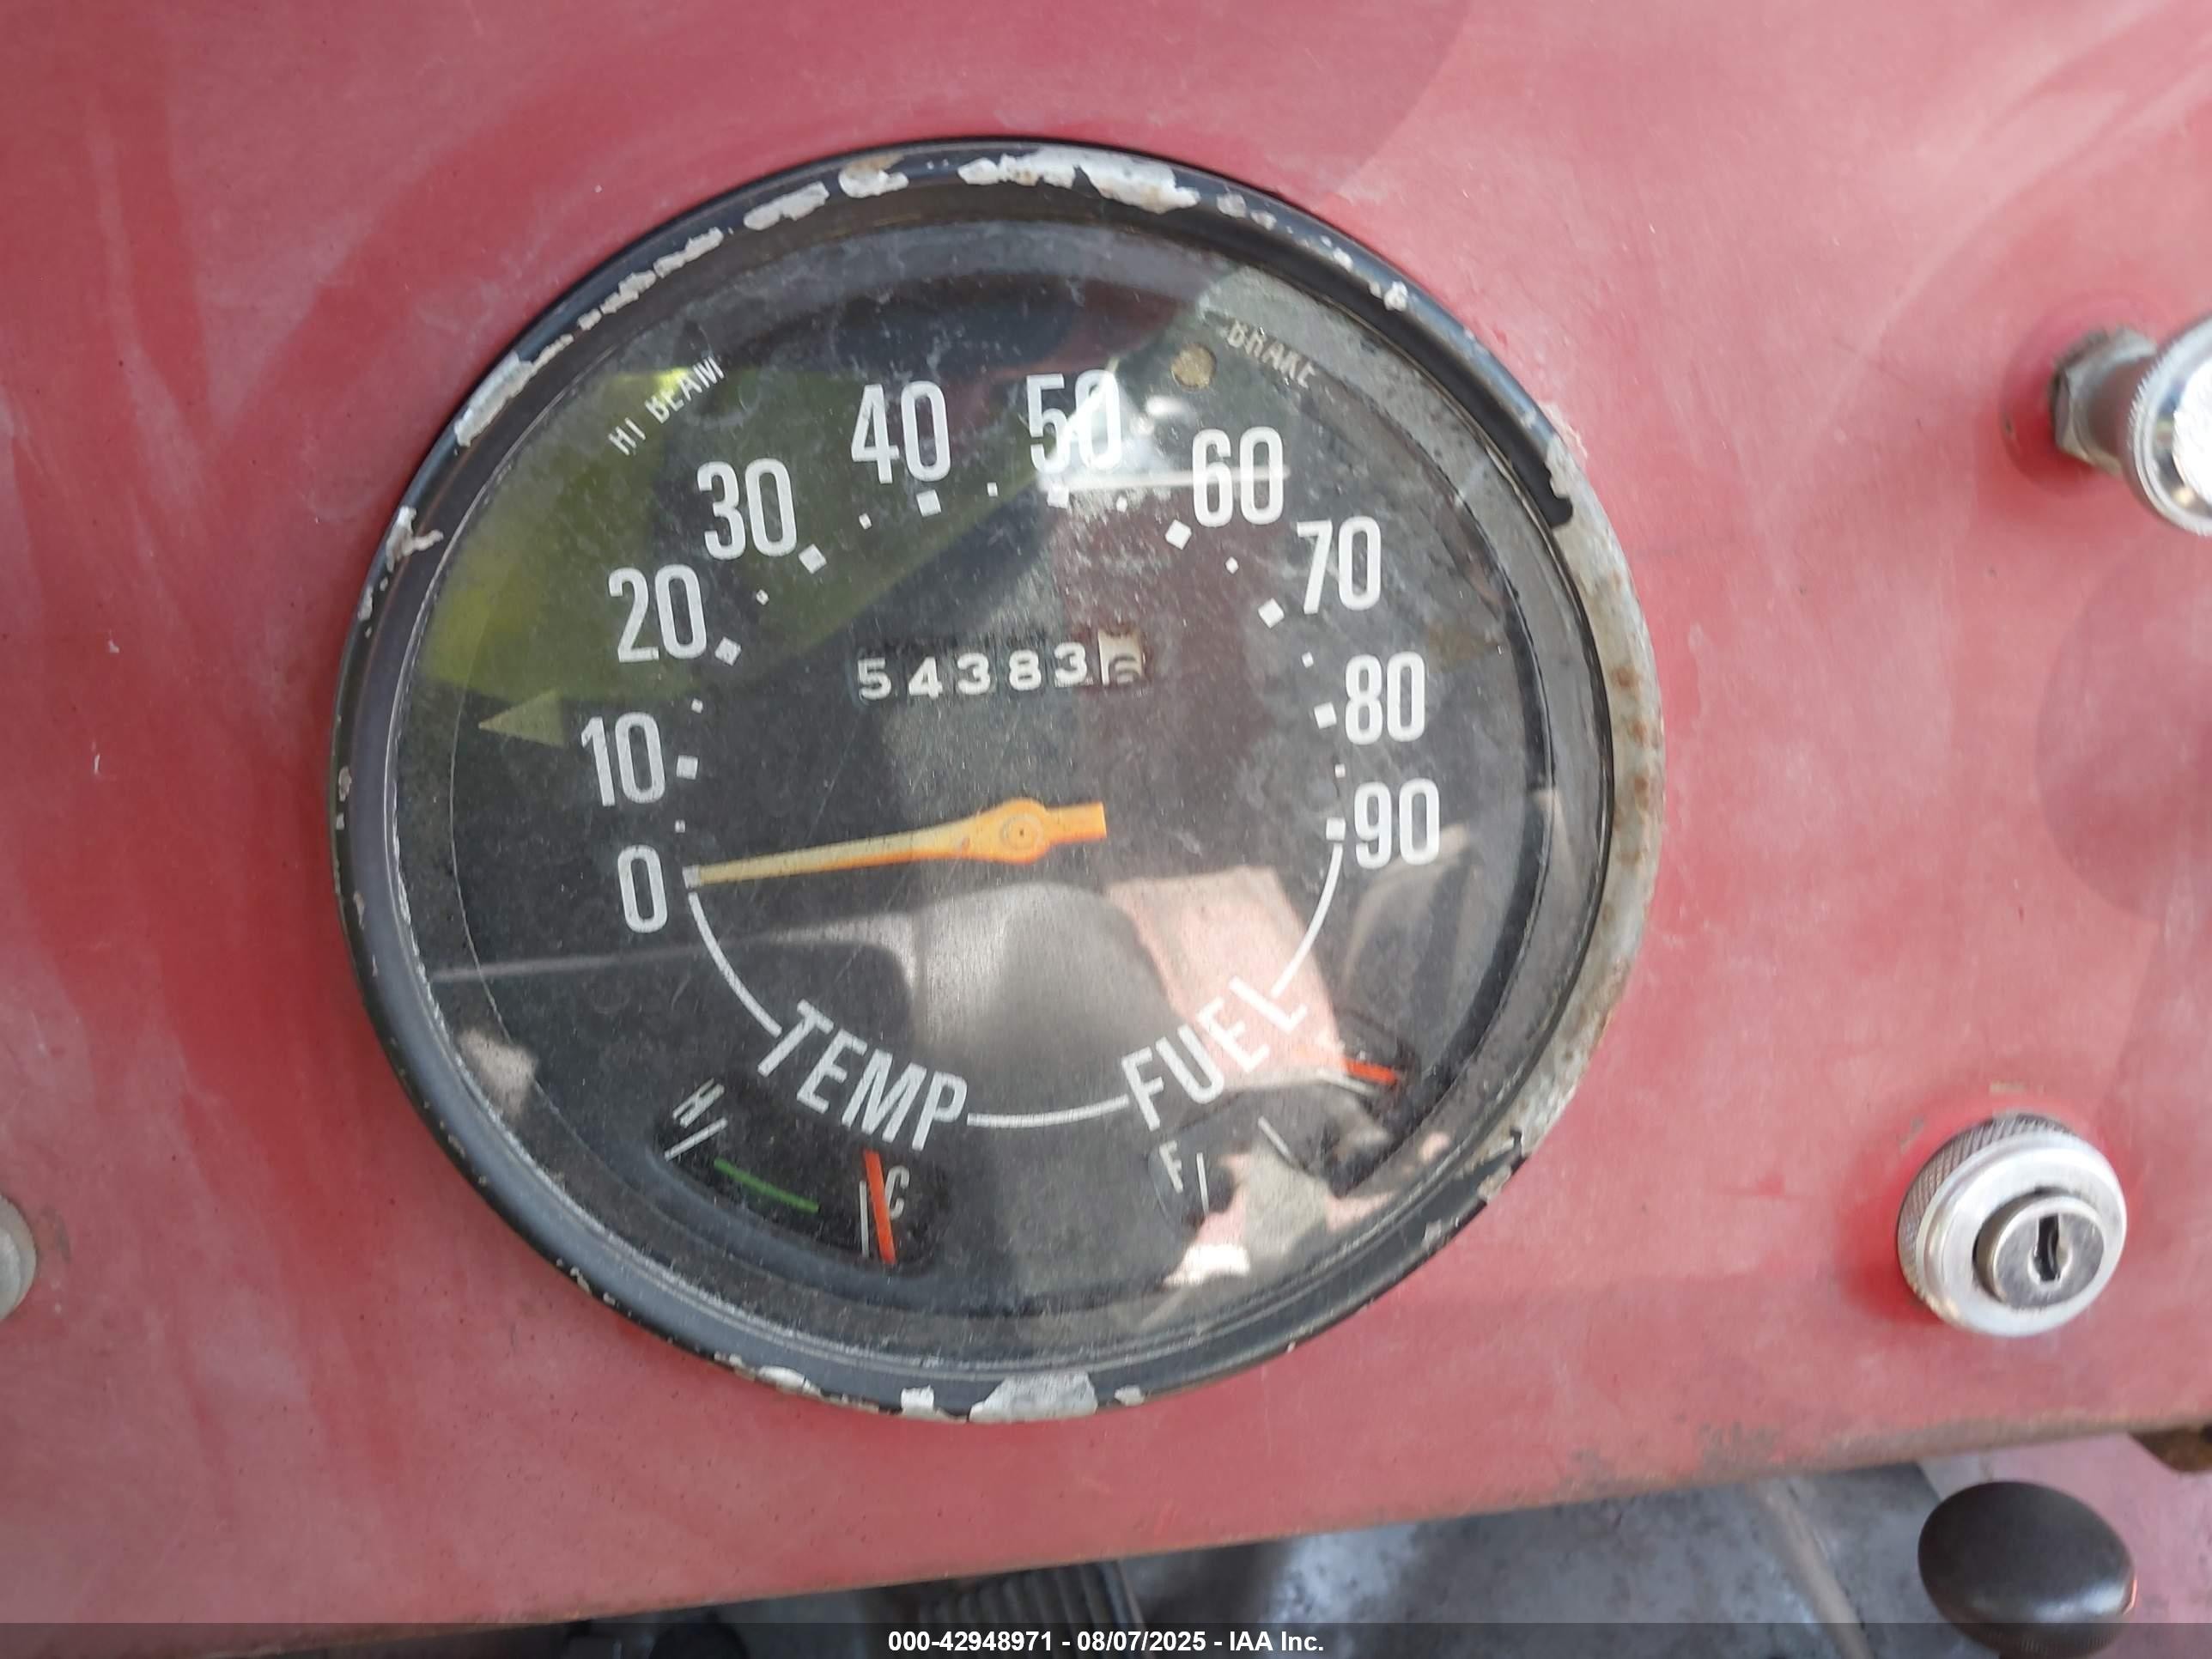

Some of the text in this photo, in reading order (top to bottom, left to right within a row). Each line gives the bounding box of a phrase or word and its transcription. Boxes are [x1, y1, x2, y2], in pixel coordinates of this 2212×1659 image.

[608, 418, 646, 456] HI
[851, 380, 951, 484] 40
[1026, 369, 1121, 474] 50
[696, 458, 798, 560] 30
[1192, 426, 1285, 527] 60
[1297, 515, 1382, 614] 70
[608, 563, 708, 663] 20
[1345, 651, 1425, 745] 80
[580, 712, 665, 806] 10
[1354, 778, 1440, 869] 90
[617, 844, 668, 933] 0
[757, 999, 969, 1152] TEMP
[1121, 975, 1309, 1132] FUEL
[672, 1077, 726, 1129] H
[884, 1164, 911, 1220] C
[1158, 1139, 1183, 1194] F
